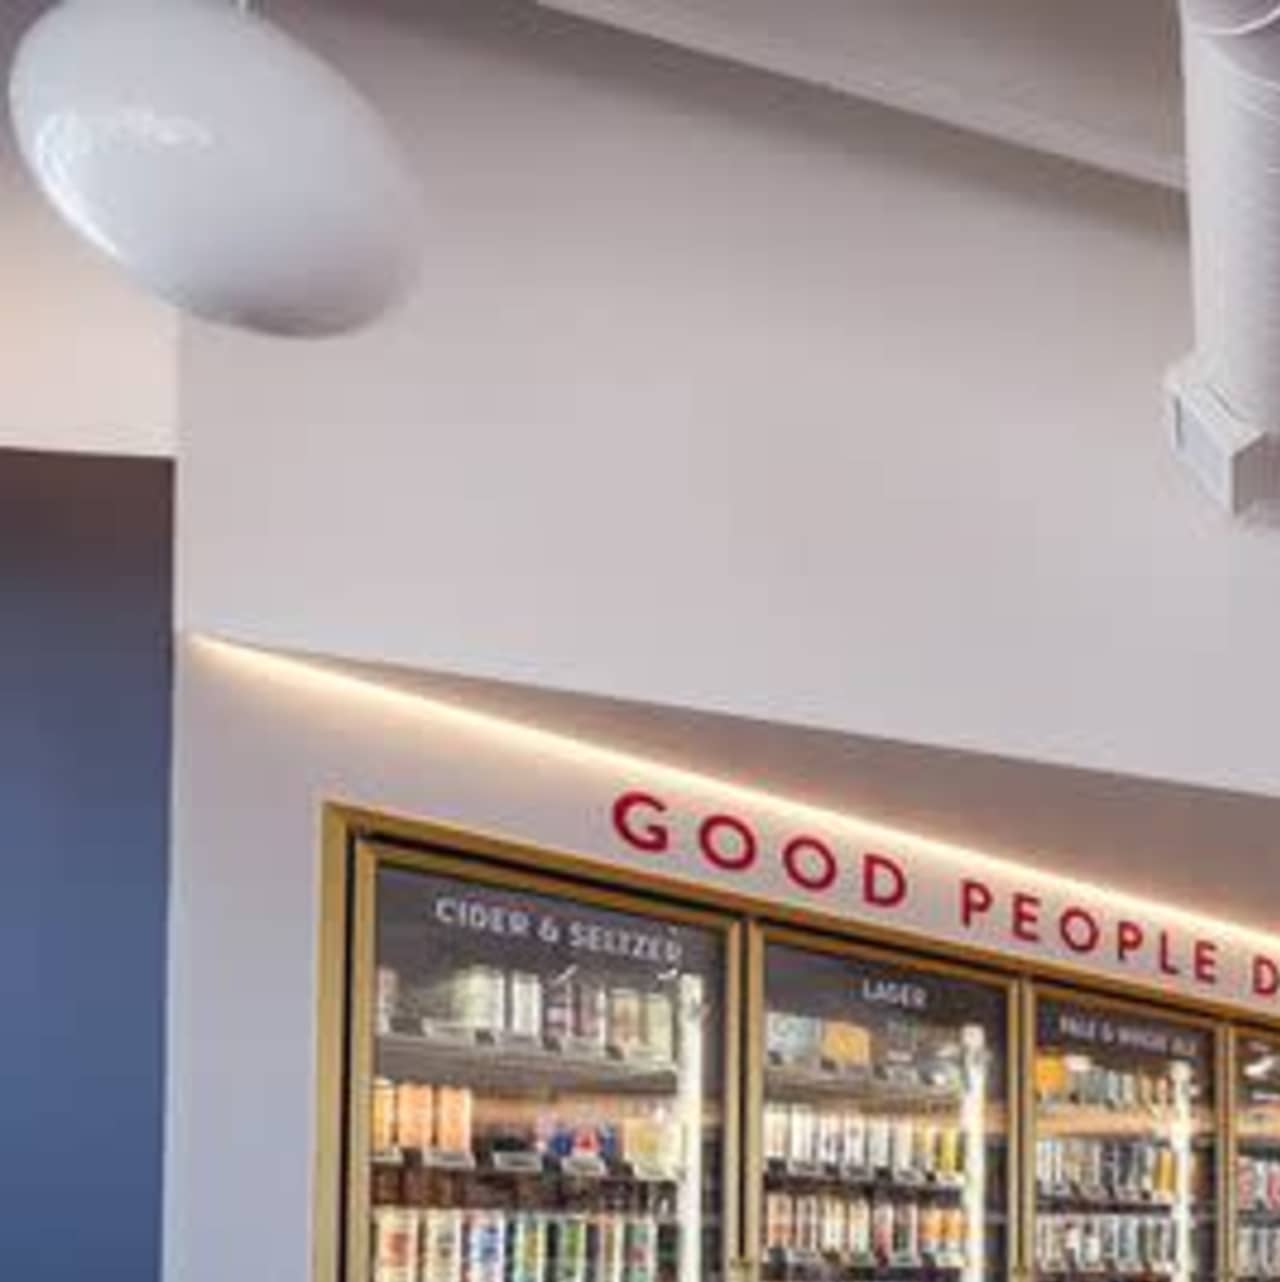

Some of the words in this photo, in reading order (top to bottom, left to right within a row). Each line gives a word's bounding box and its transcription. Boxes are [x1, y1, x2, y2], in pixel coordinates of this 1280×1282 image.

[612, 791, 907, 908] GOOD
[960, 878, 1218, 984] PEOPLE
[434, 897, 531, 936] CIDER
[568, 920, 684, 963] SELTZER
[861, 978, 928, 1008] LAGER
